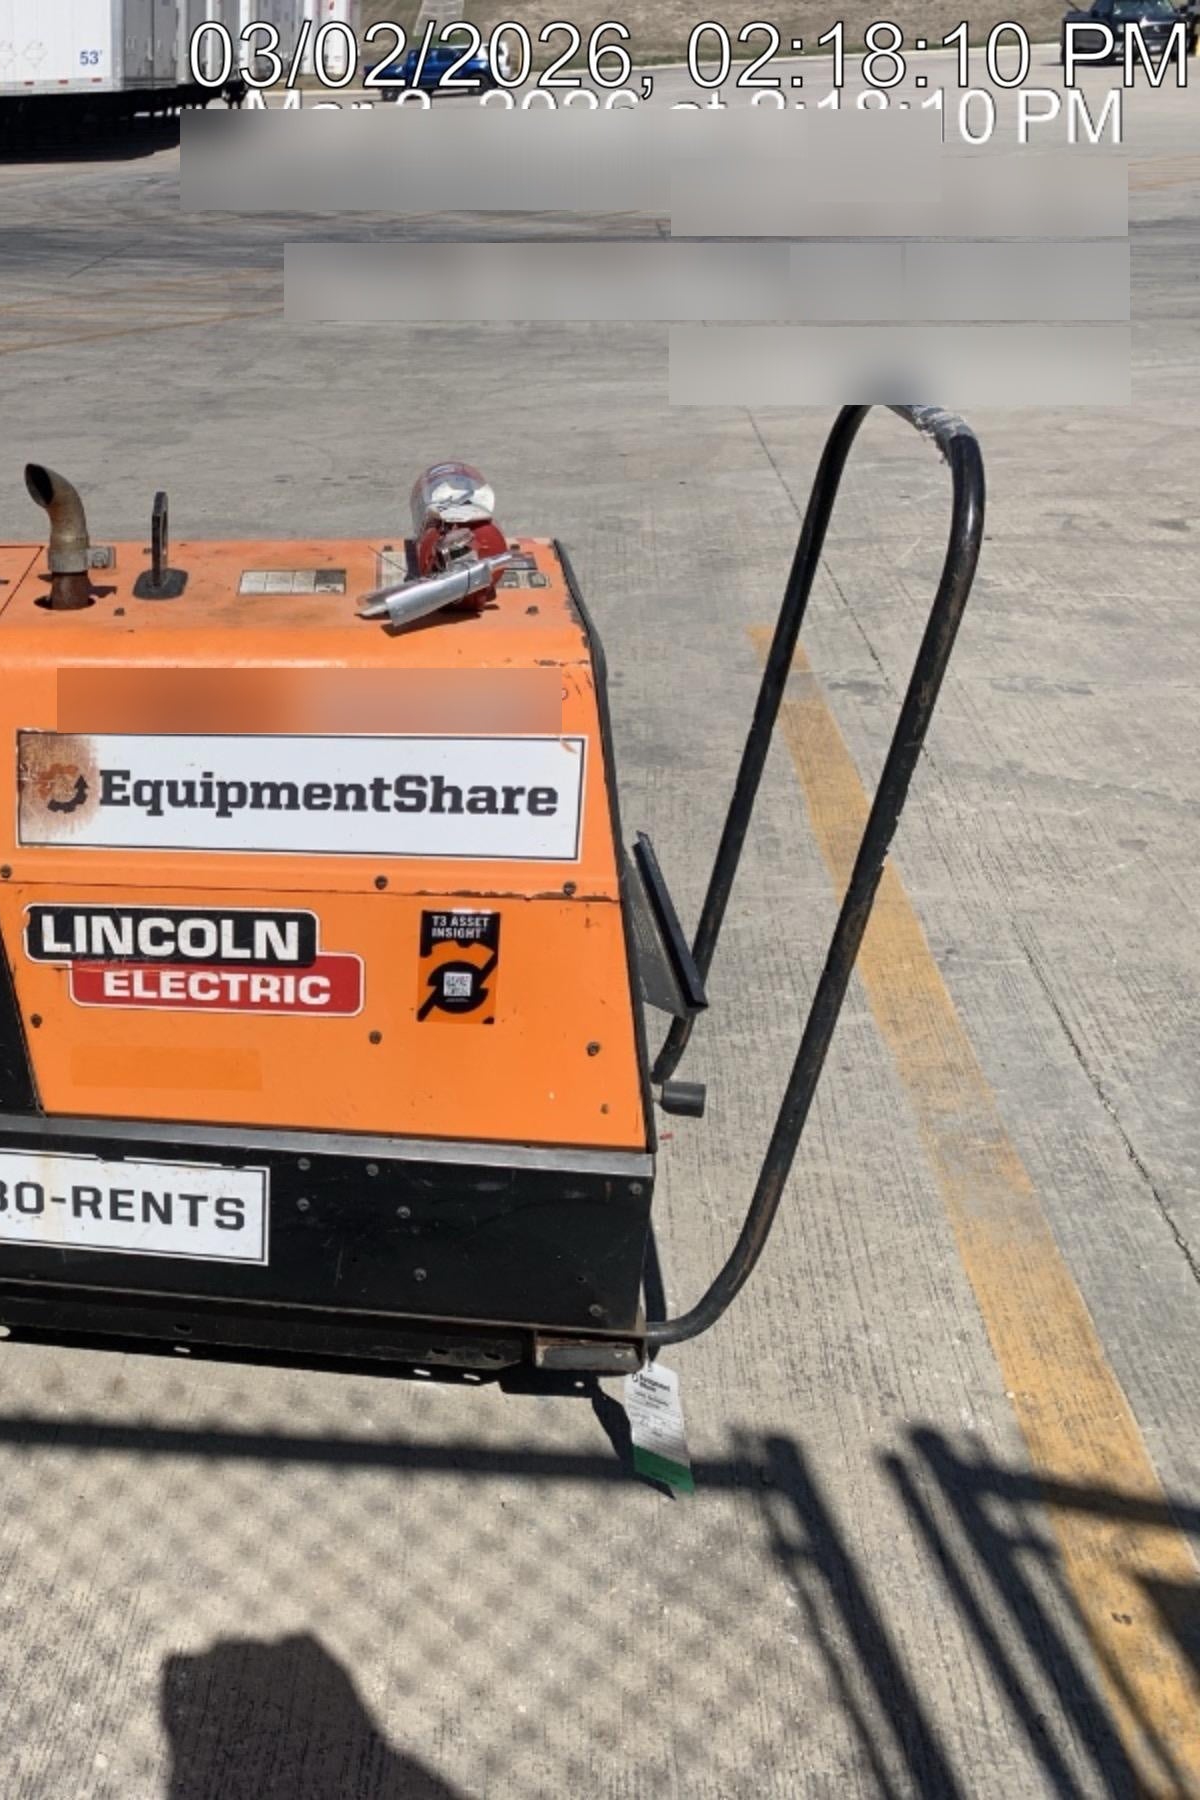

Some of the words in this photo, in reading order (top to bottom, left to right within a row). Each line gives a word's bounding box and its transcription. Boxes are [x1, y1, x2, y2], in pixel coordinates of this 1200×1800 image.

[98, 769, 559, 818] EquipmentShare
[40, 913, 300, 961] LINCOLN
[431, 915, 447, 927] T3
[450, 916, 490, 928] ASSET
[103, 969, 331, 1005] ELECTRIC
